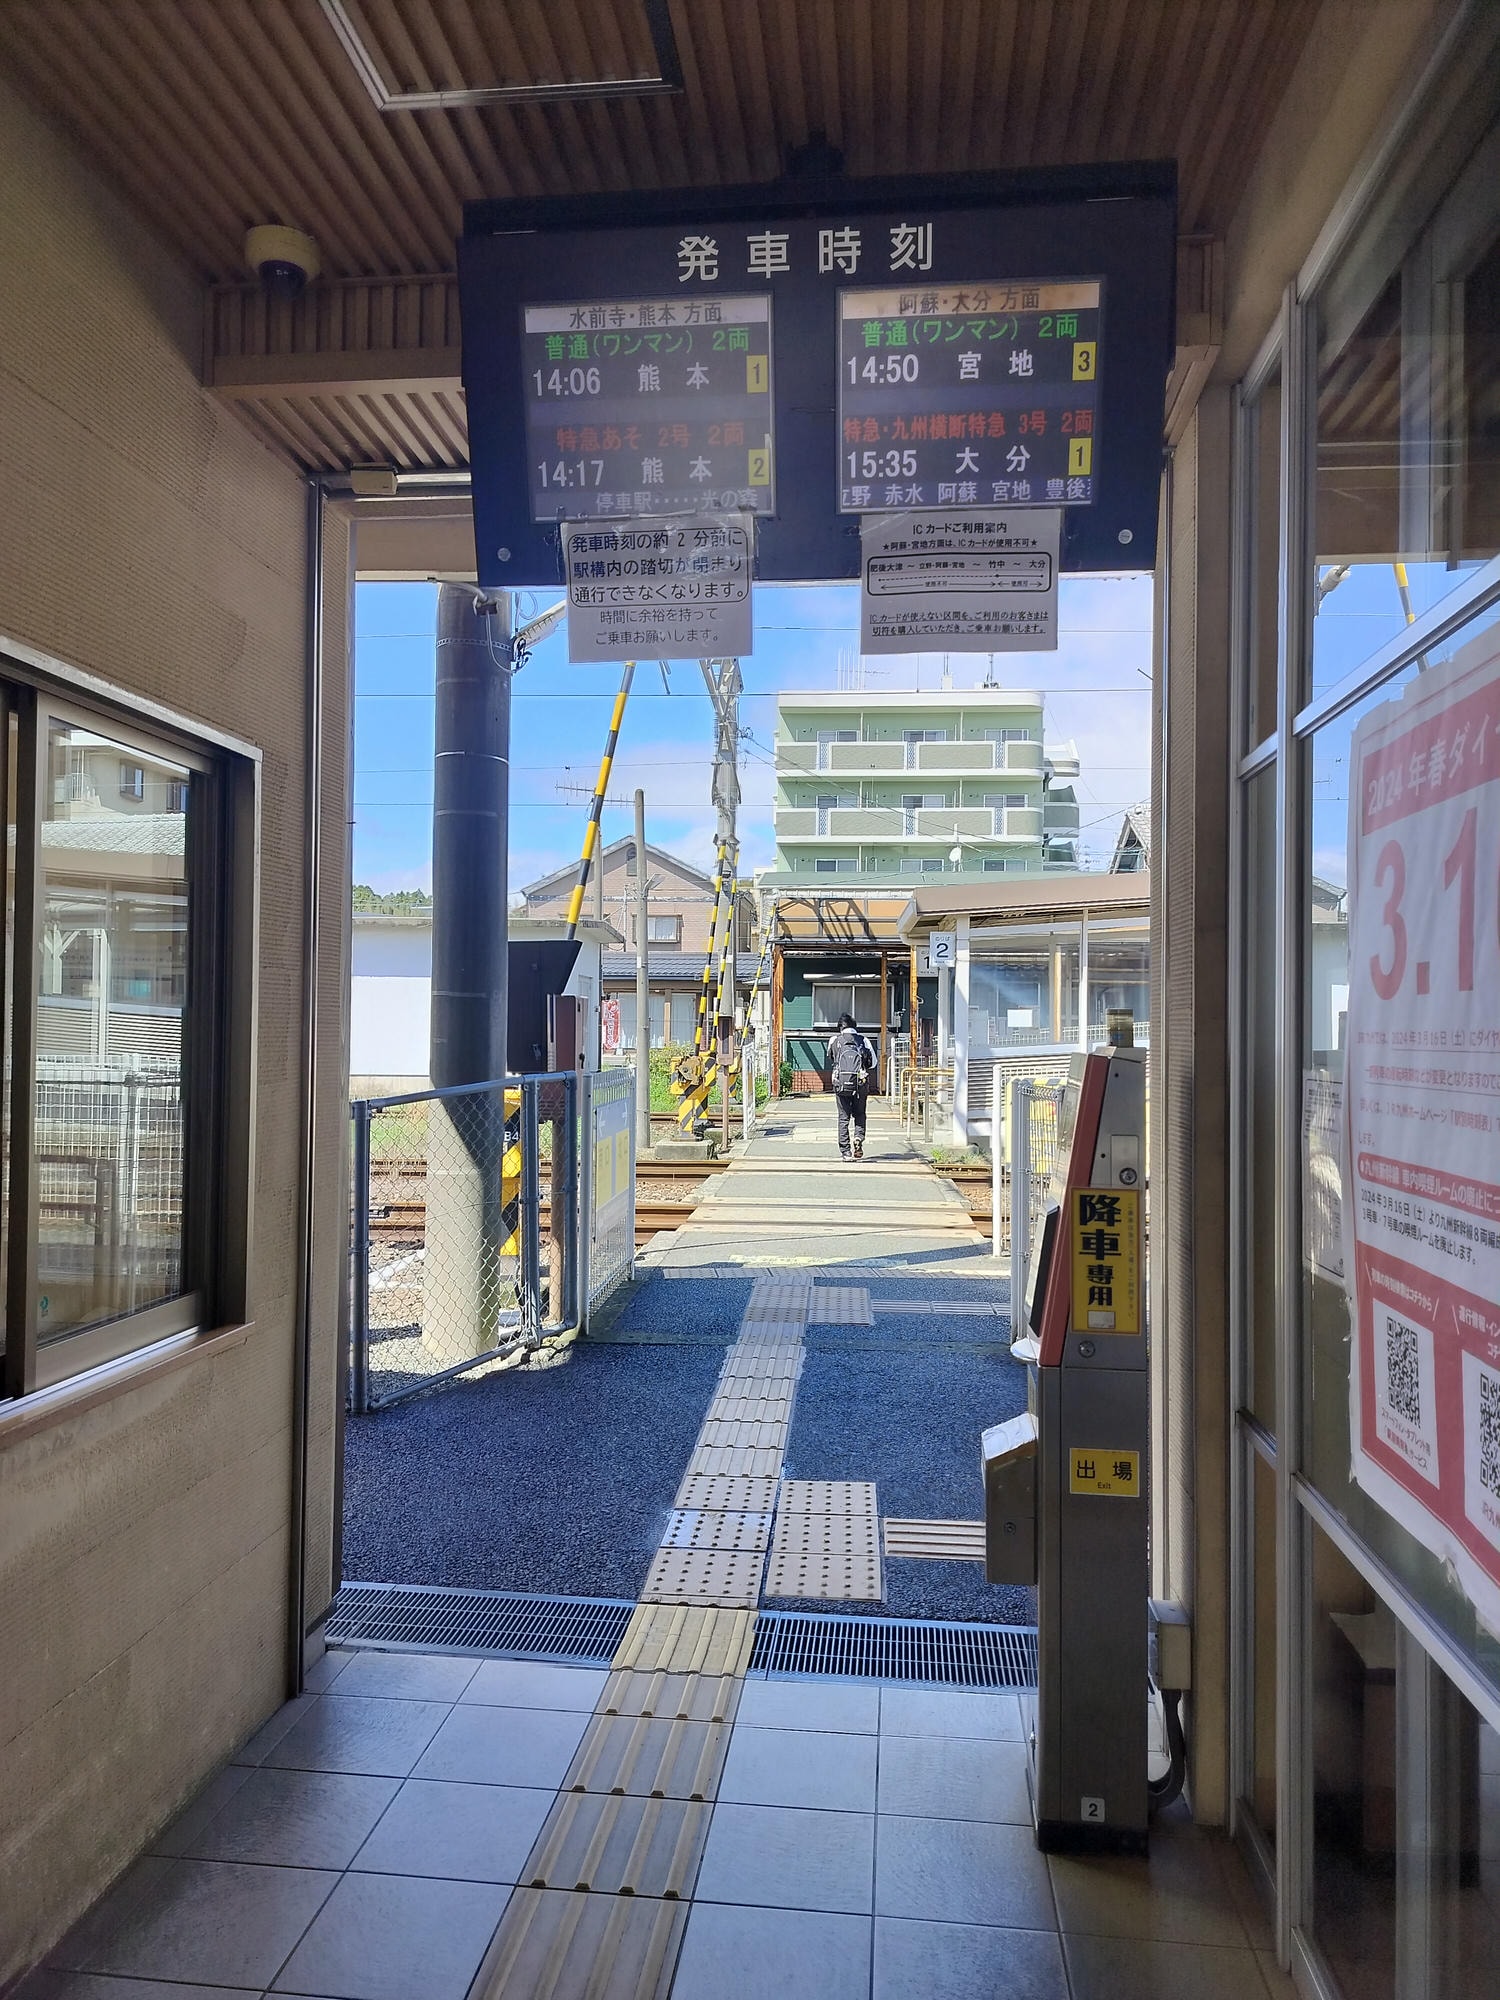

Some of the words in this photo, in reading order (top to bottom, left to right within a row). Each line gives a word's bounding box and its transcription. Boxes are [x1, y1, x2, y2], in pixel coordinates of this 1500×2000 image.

[677, 222, 932, 282] 発車時刻
[1000, 288, 1041, 311] 方面
[684, 302, 722, 324] 方面
[1038, 314, 1079, 339] 2両
[712, 328, 749, 352] 2両
[847, 354, 919, 385] 14:50
[1078, 350, 1091, 372] 3
[533, 367, 601, 397] 14:06
[753, 363, 761, 384] 1
[658, 424, 692, 449] 2号
[708, 421, 745, 447] 2両
[1018, 411, 1048, 436] 3号
[1061, 410, 1093, 434] 2両
[538, 460, 604, 488] 14:17
[753, 457, 765, 478] 2
[847, 450, 918, 479] 15:35
[1076, 446, 1084, 468] 1
[938, 481, 977, 503] 阿蘇
[992, 480, 1031, 502] 宮地
[1046, 477, 1092, 500] 豊後
[988, 560, 1006, 569] 竹中
[1028, 560, 1046, 568] 大分
[575, 581, 744, 604] 通行できなくなります。
[600, 608, 718, 625] 時間に余裕を持って
[596, 629, 719, 645] ご乗車お願いします。
[1370, 807, 1500, 1000] 3.1
[924, 956, 930, 969] 1
[936, 943, 949, 958] 2
[1078, 1193, 1122, 1306] 降車専用
[1077, 1459, 1133, 1481] 出場
[1097, 1481, 1112, 1489] Exit
[1088, 1804, 1098, 1817] 2
